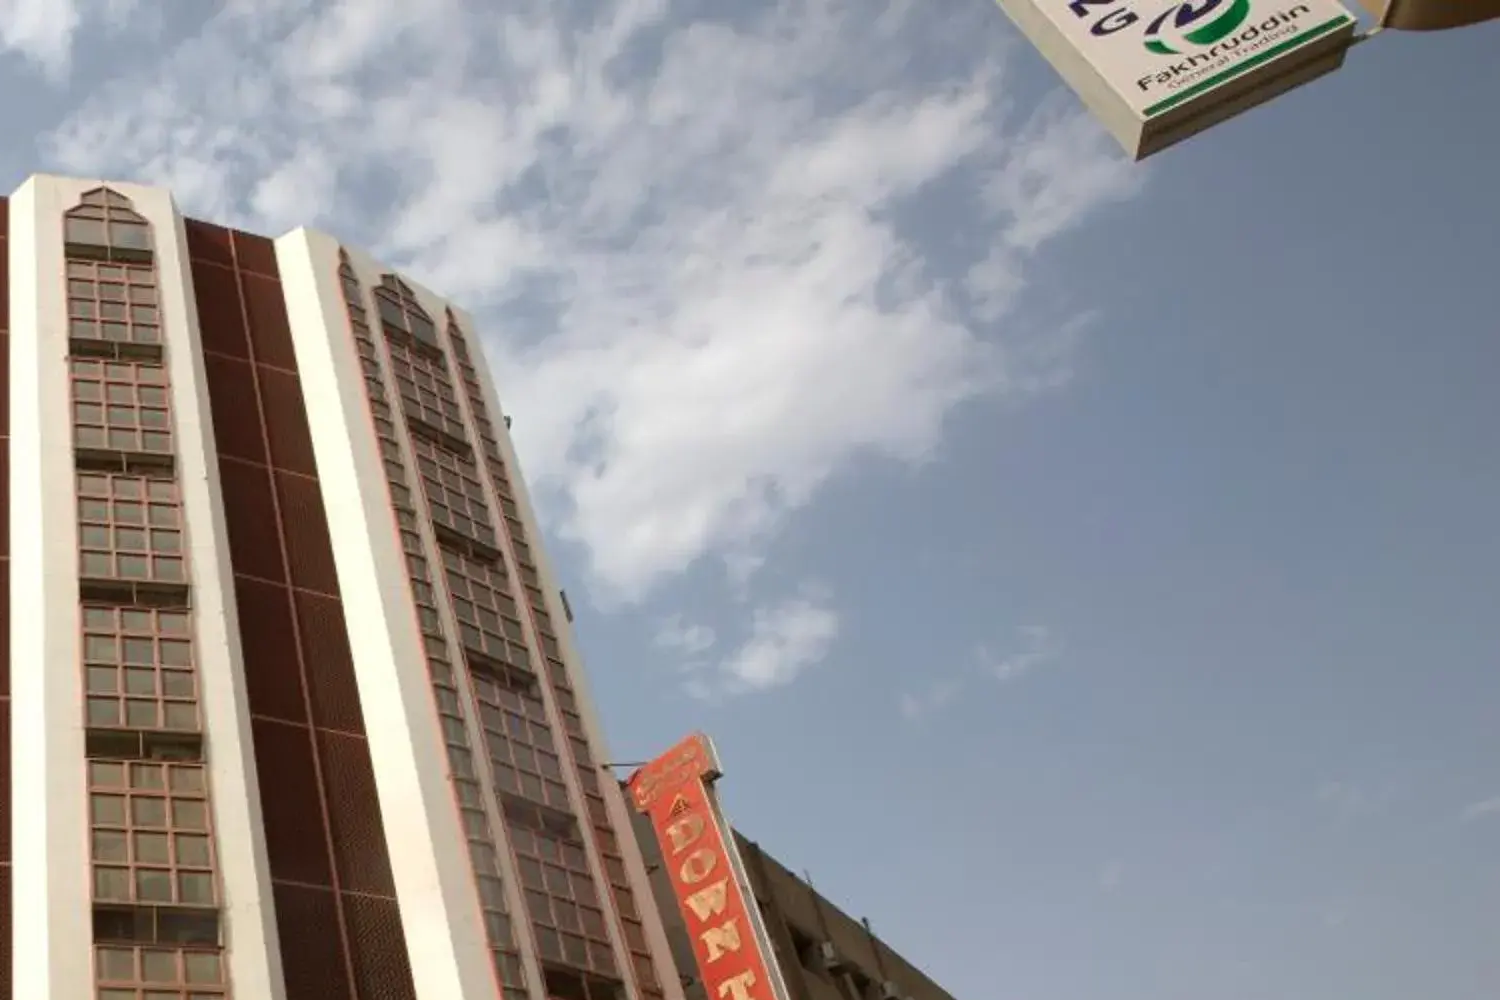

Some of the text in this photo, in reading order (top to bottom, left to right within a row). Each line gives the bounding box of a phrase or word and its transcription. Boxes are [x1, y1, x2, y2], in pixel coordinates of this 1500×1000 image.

[1136, 5, 1311, 92] Fakhruddin
[1166, 24, 1300, 91] General Trading
[665, 816, 740, 965] DOWN
